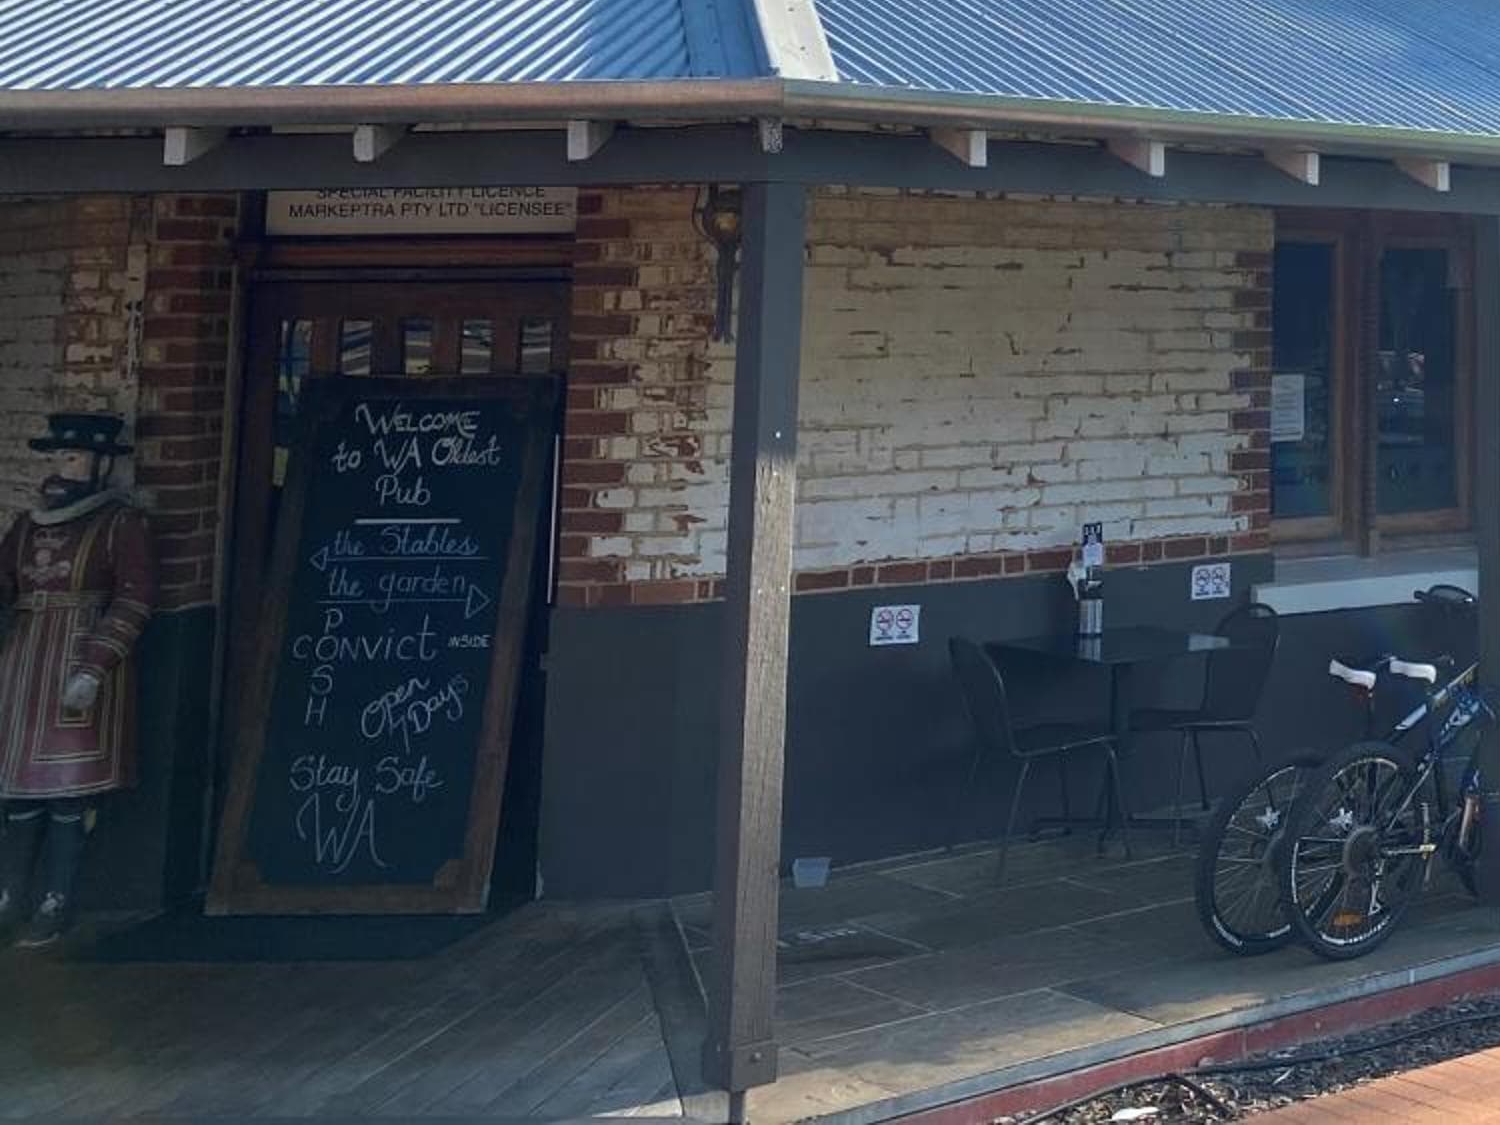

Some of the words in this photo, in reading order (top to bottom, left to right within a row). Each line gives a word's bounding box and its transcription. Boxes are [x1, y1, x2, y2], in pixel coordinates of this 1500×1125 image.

[317, 187, 388, 199] SPECIAL
[472, 187, 546, 198] LICENCE
[401, 203, 434, 217] PTY
[438, 203, 469, 217] LTD
[332, 440, 361, 472] to
[374, 435, 423, 475] WA
[375, 475, 431, 506] Pub
[333, 530, 366, 556] the
[380, 523, 479, 556] Stables
[328, 567, 365, 597] the
[447, 633, 491, 648] INSIDE
[361, 677, 430, 739] Open
[289, 755, 360, 812] Stay
[375, 755, 444, 802] Safe
[295, 792, 390, 875] WA
